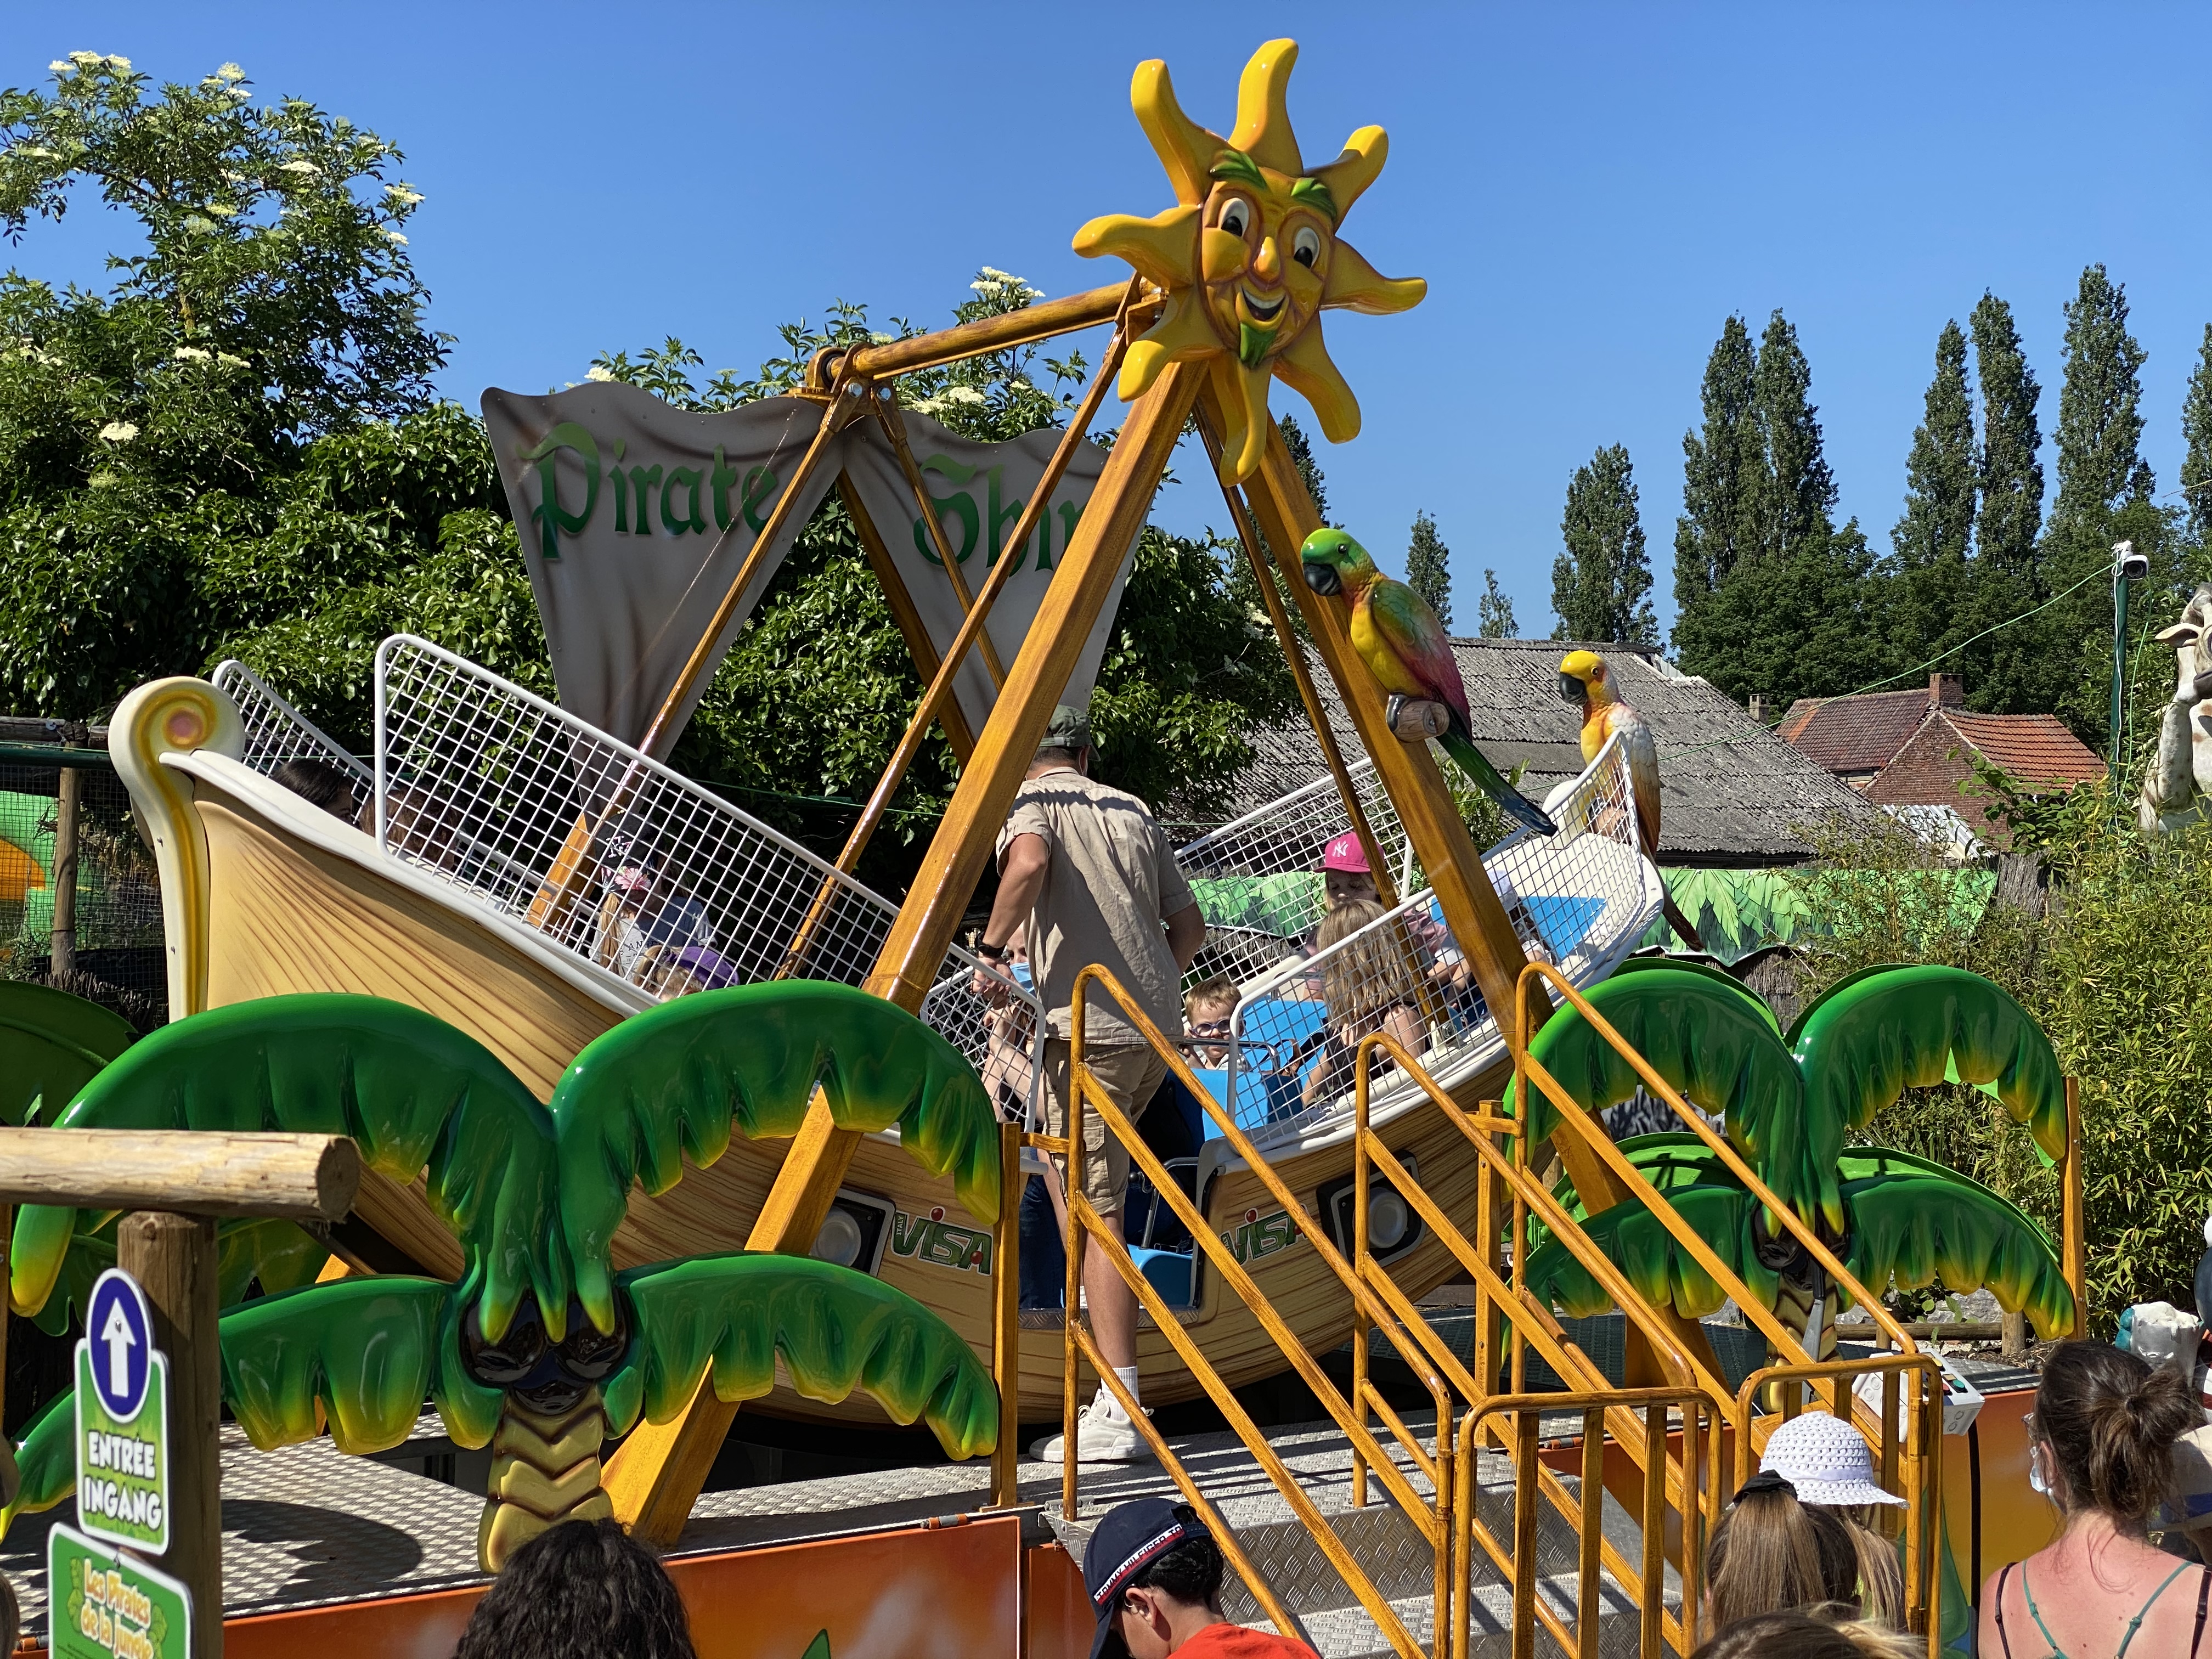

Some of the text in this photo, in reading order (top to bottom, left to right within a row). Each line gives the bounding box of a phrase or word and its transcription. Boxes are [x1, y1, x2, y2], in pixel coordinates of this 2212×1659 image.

[515, 422, 777, 558] Pirate
[1332, 840, 1349, 857] NY
[896, 1216, 904, 1235] ITALY
[88, 1430, 156, 1480] ENTRÉE
[83, 1474, 162, 1531] INGANG
[84, 1558, 151, 1630] Les Pirates
[1097, 1568, 1123, 1599] TOMMY
[81, 1598, 99, 1641] de
[99, 1605, 113, 1649] la
